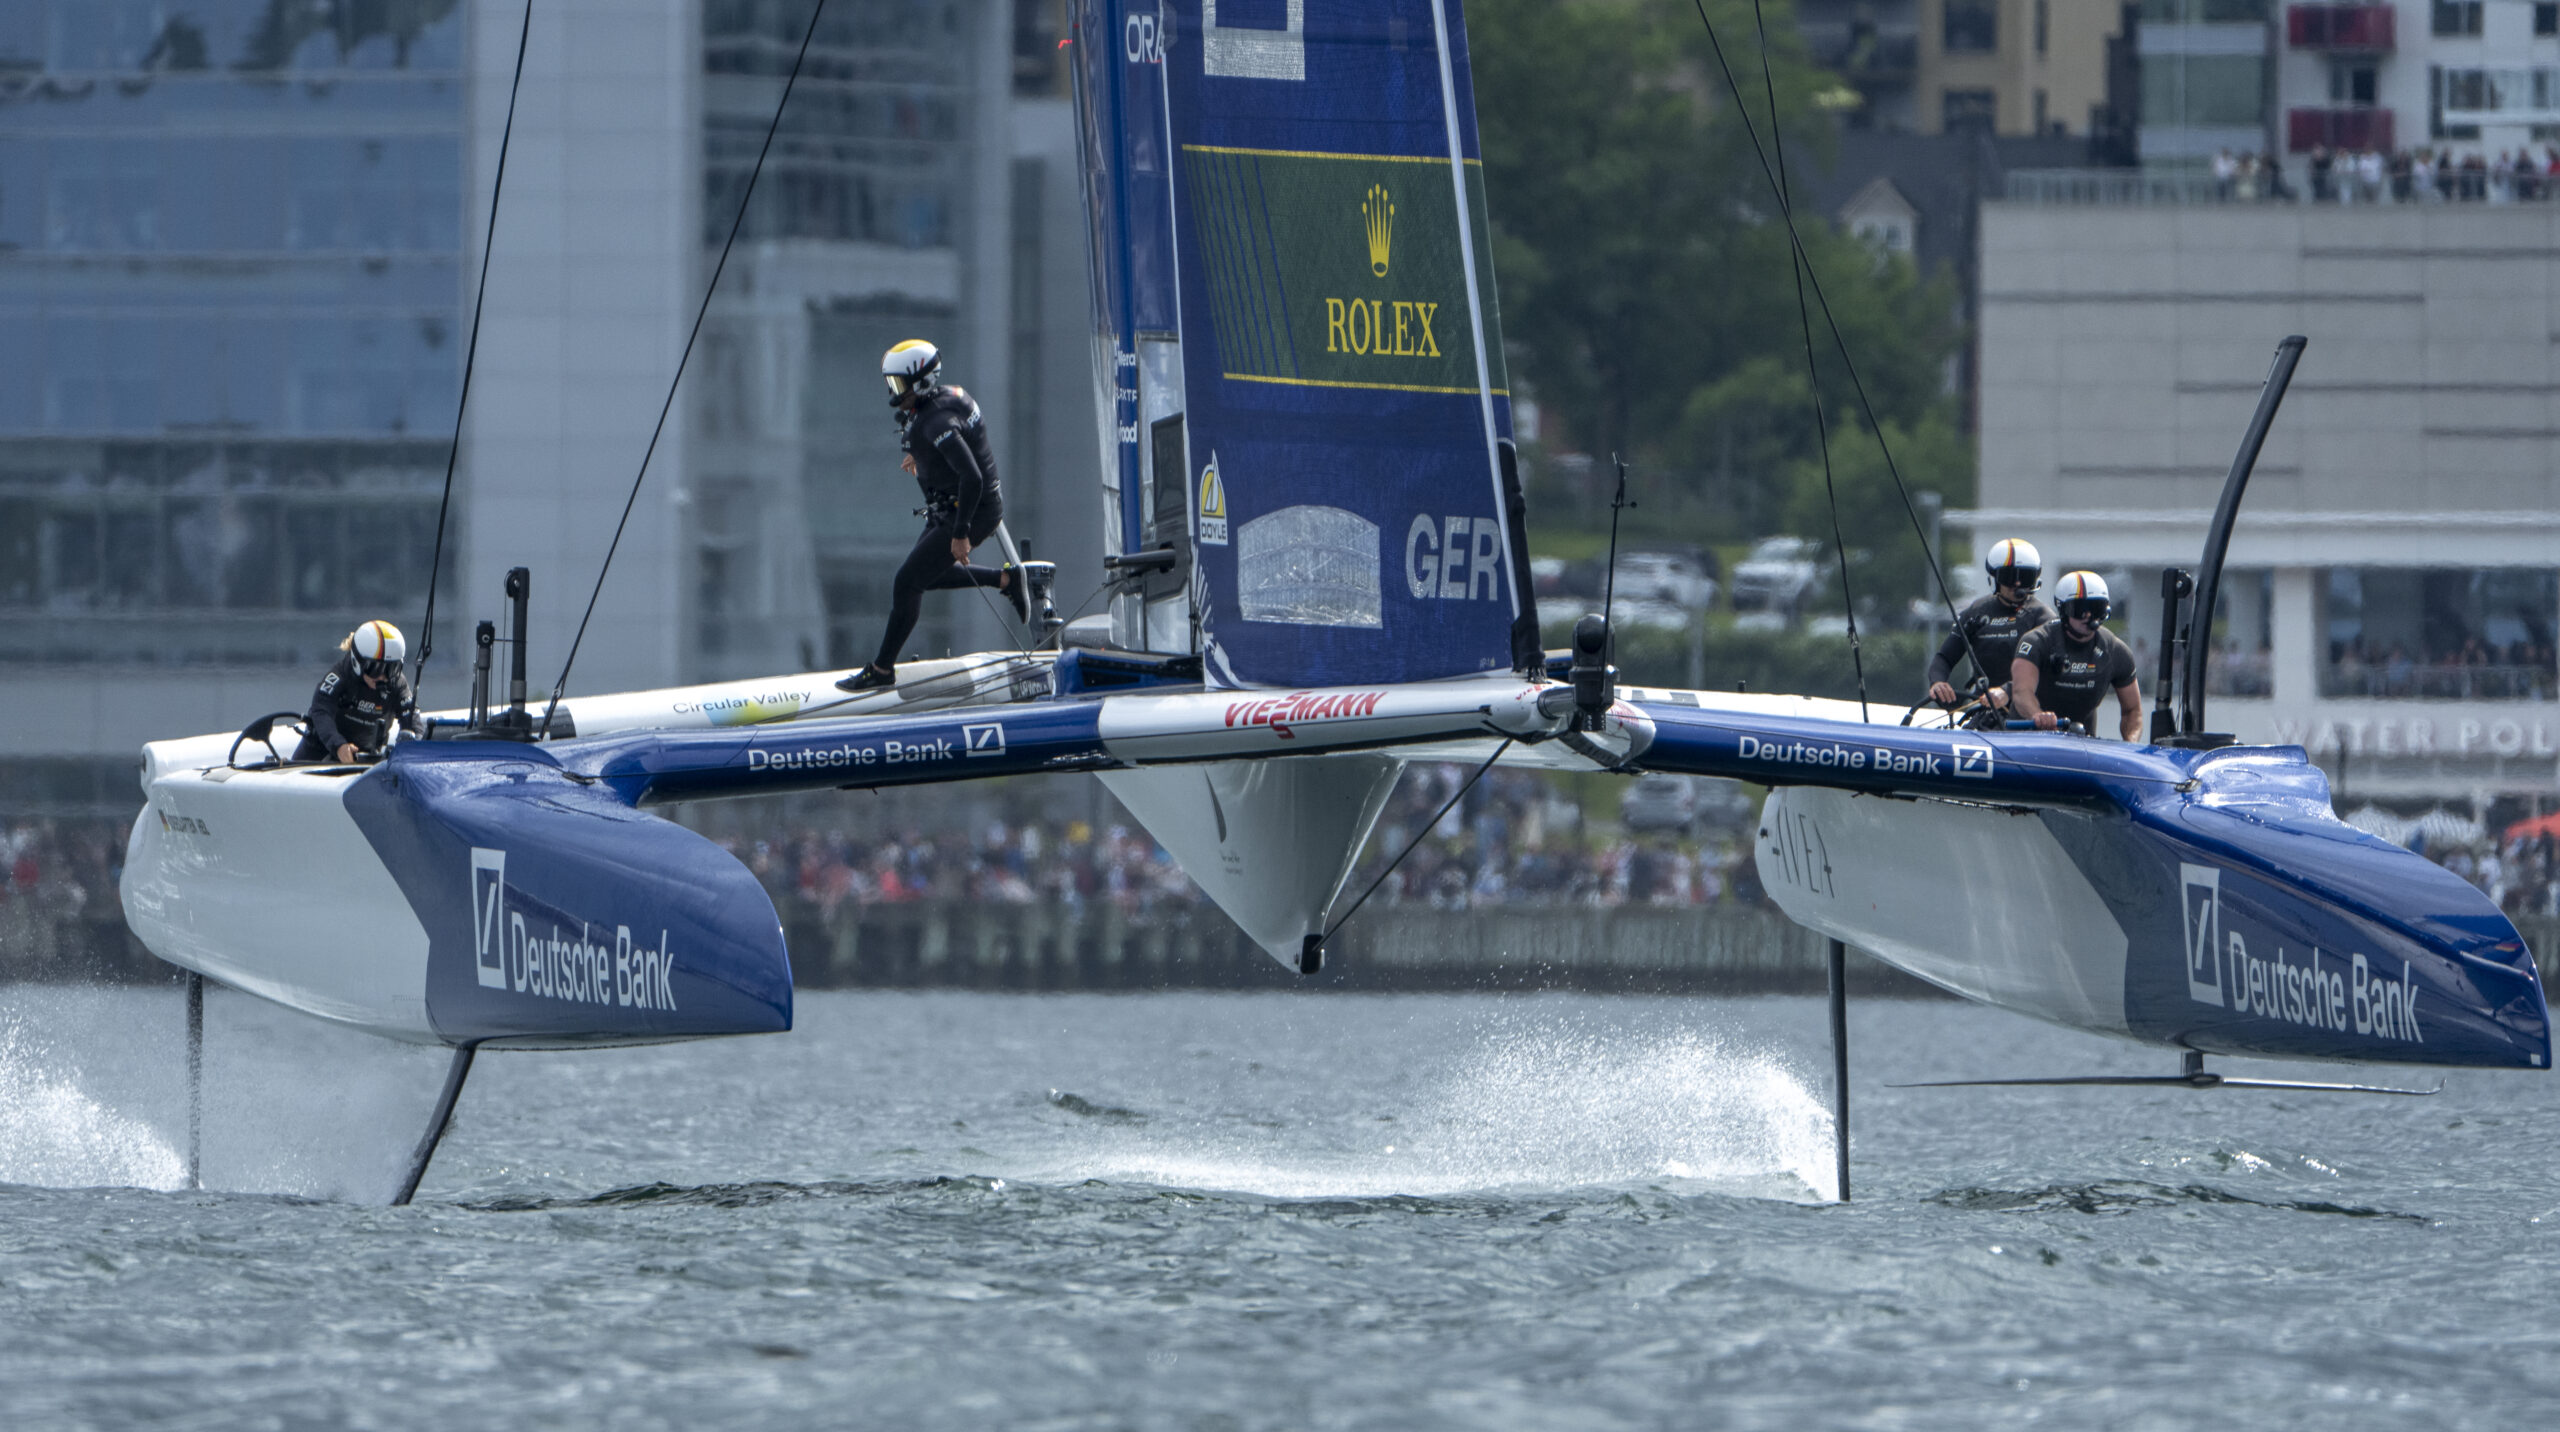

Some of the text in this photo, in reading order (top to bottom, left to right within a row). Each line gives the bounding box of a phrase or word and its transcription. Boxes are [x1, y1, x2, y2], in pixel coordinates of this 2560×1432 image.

[1325, 297, 1441, 357] ROLEX
[1201, 522, 1227, 540] DOYLE
[1405, 513, 1501, 601] GER
[672, 691, 811, 714] Circular Valley
[1225, 691, 1388, 740] VIESSMANN
[748, 737, 954, 771] Deutsche Bank
[1738, 736, 1941, 775] Deutsche Bank
[2270, 718, 2434, 757] WATER
[511, 911, 677, 1011] Deutsche Bank
[2229, 930, 2424, 1043] Deutsche Bank
